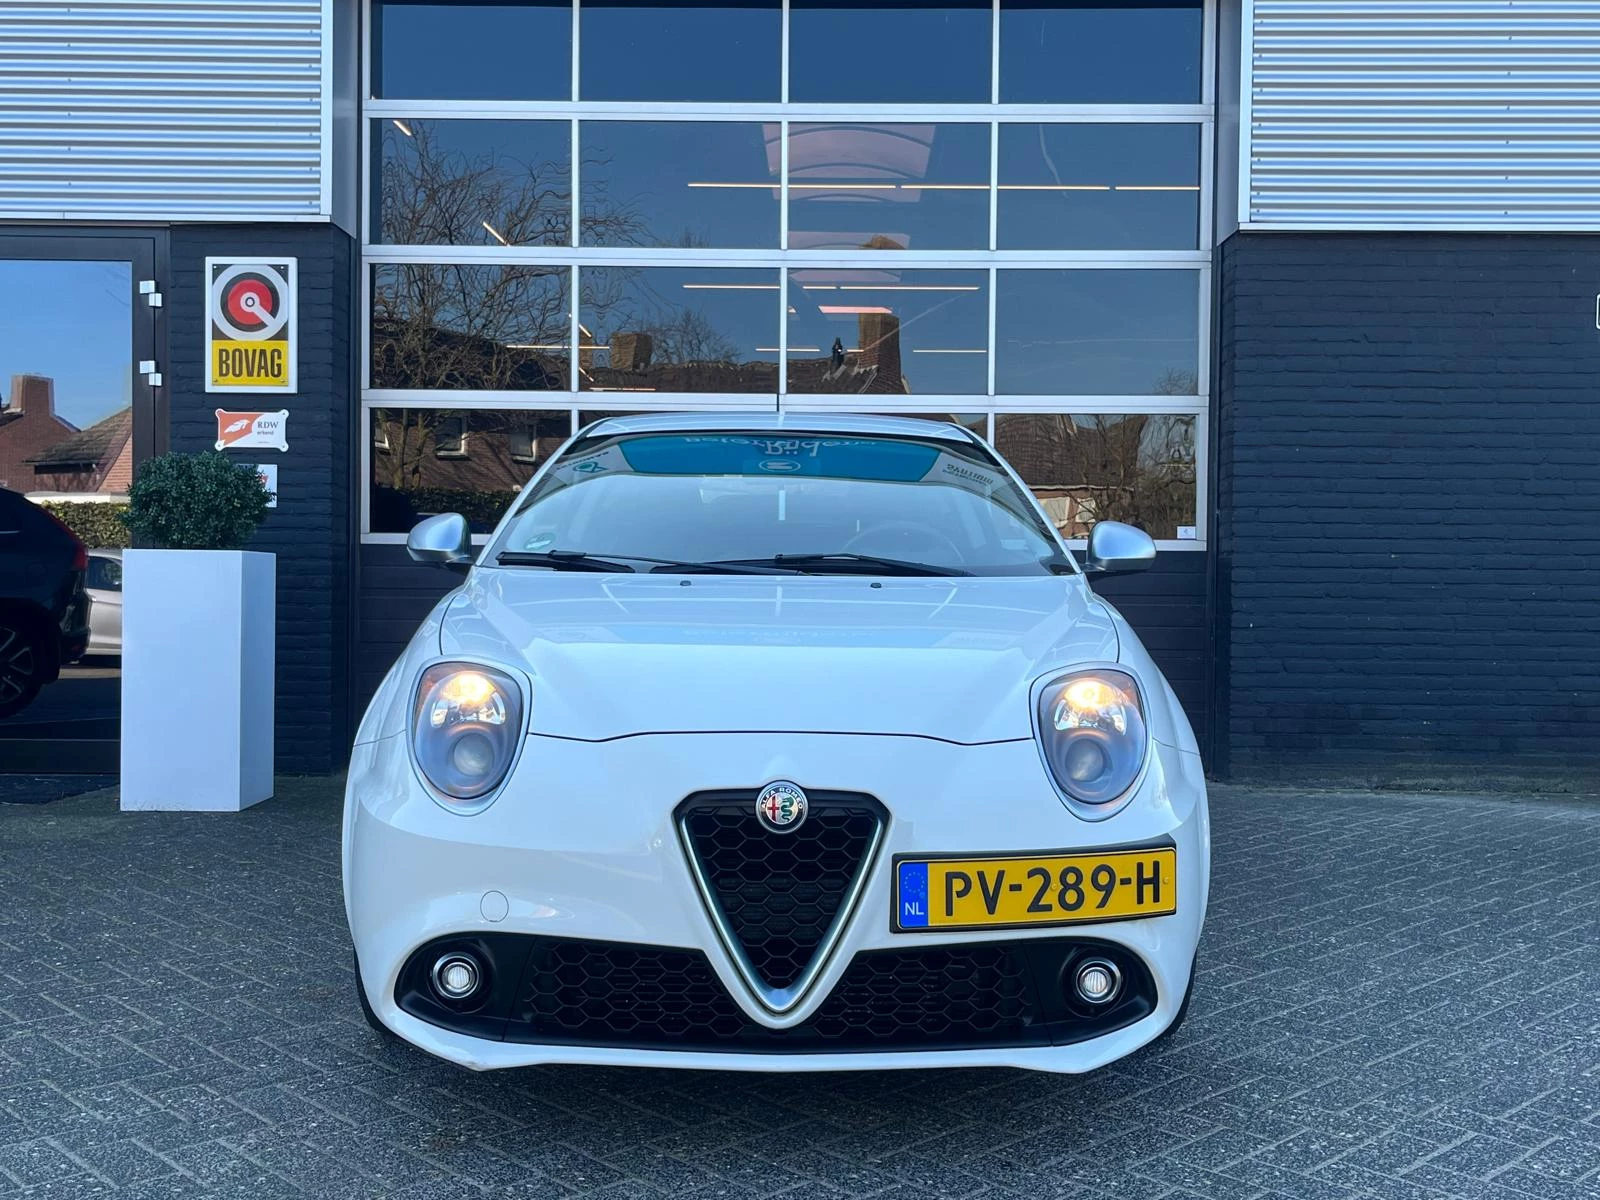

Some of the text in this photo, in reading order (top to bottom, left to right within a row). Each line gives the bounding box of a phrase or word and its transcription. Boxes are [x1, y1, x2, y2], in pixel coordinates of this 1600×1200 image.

[218, 348, 282, 378] BOVAG
[257, 421, 279, 429] RDW
[761, 787, 803, 809] ALFA ROMEO
[904, 860, 1161, 917] NL PV-289-H
